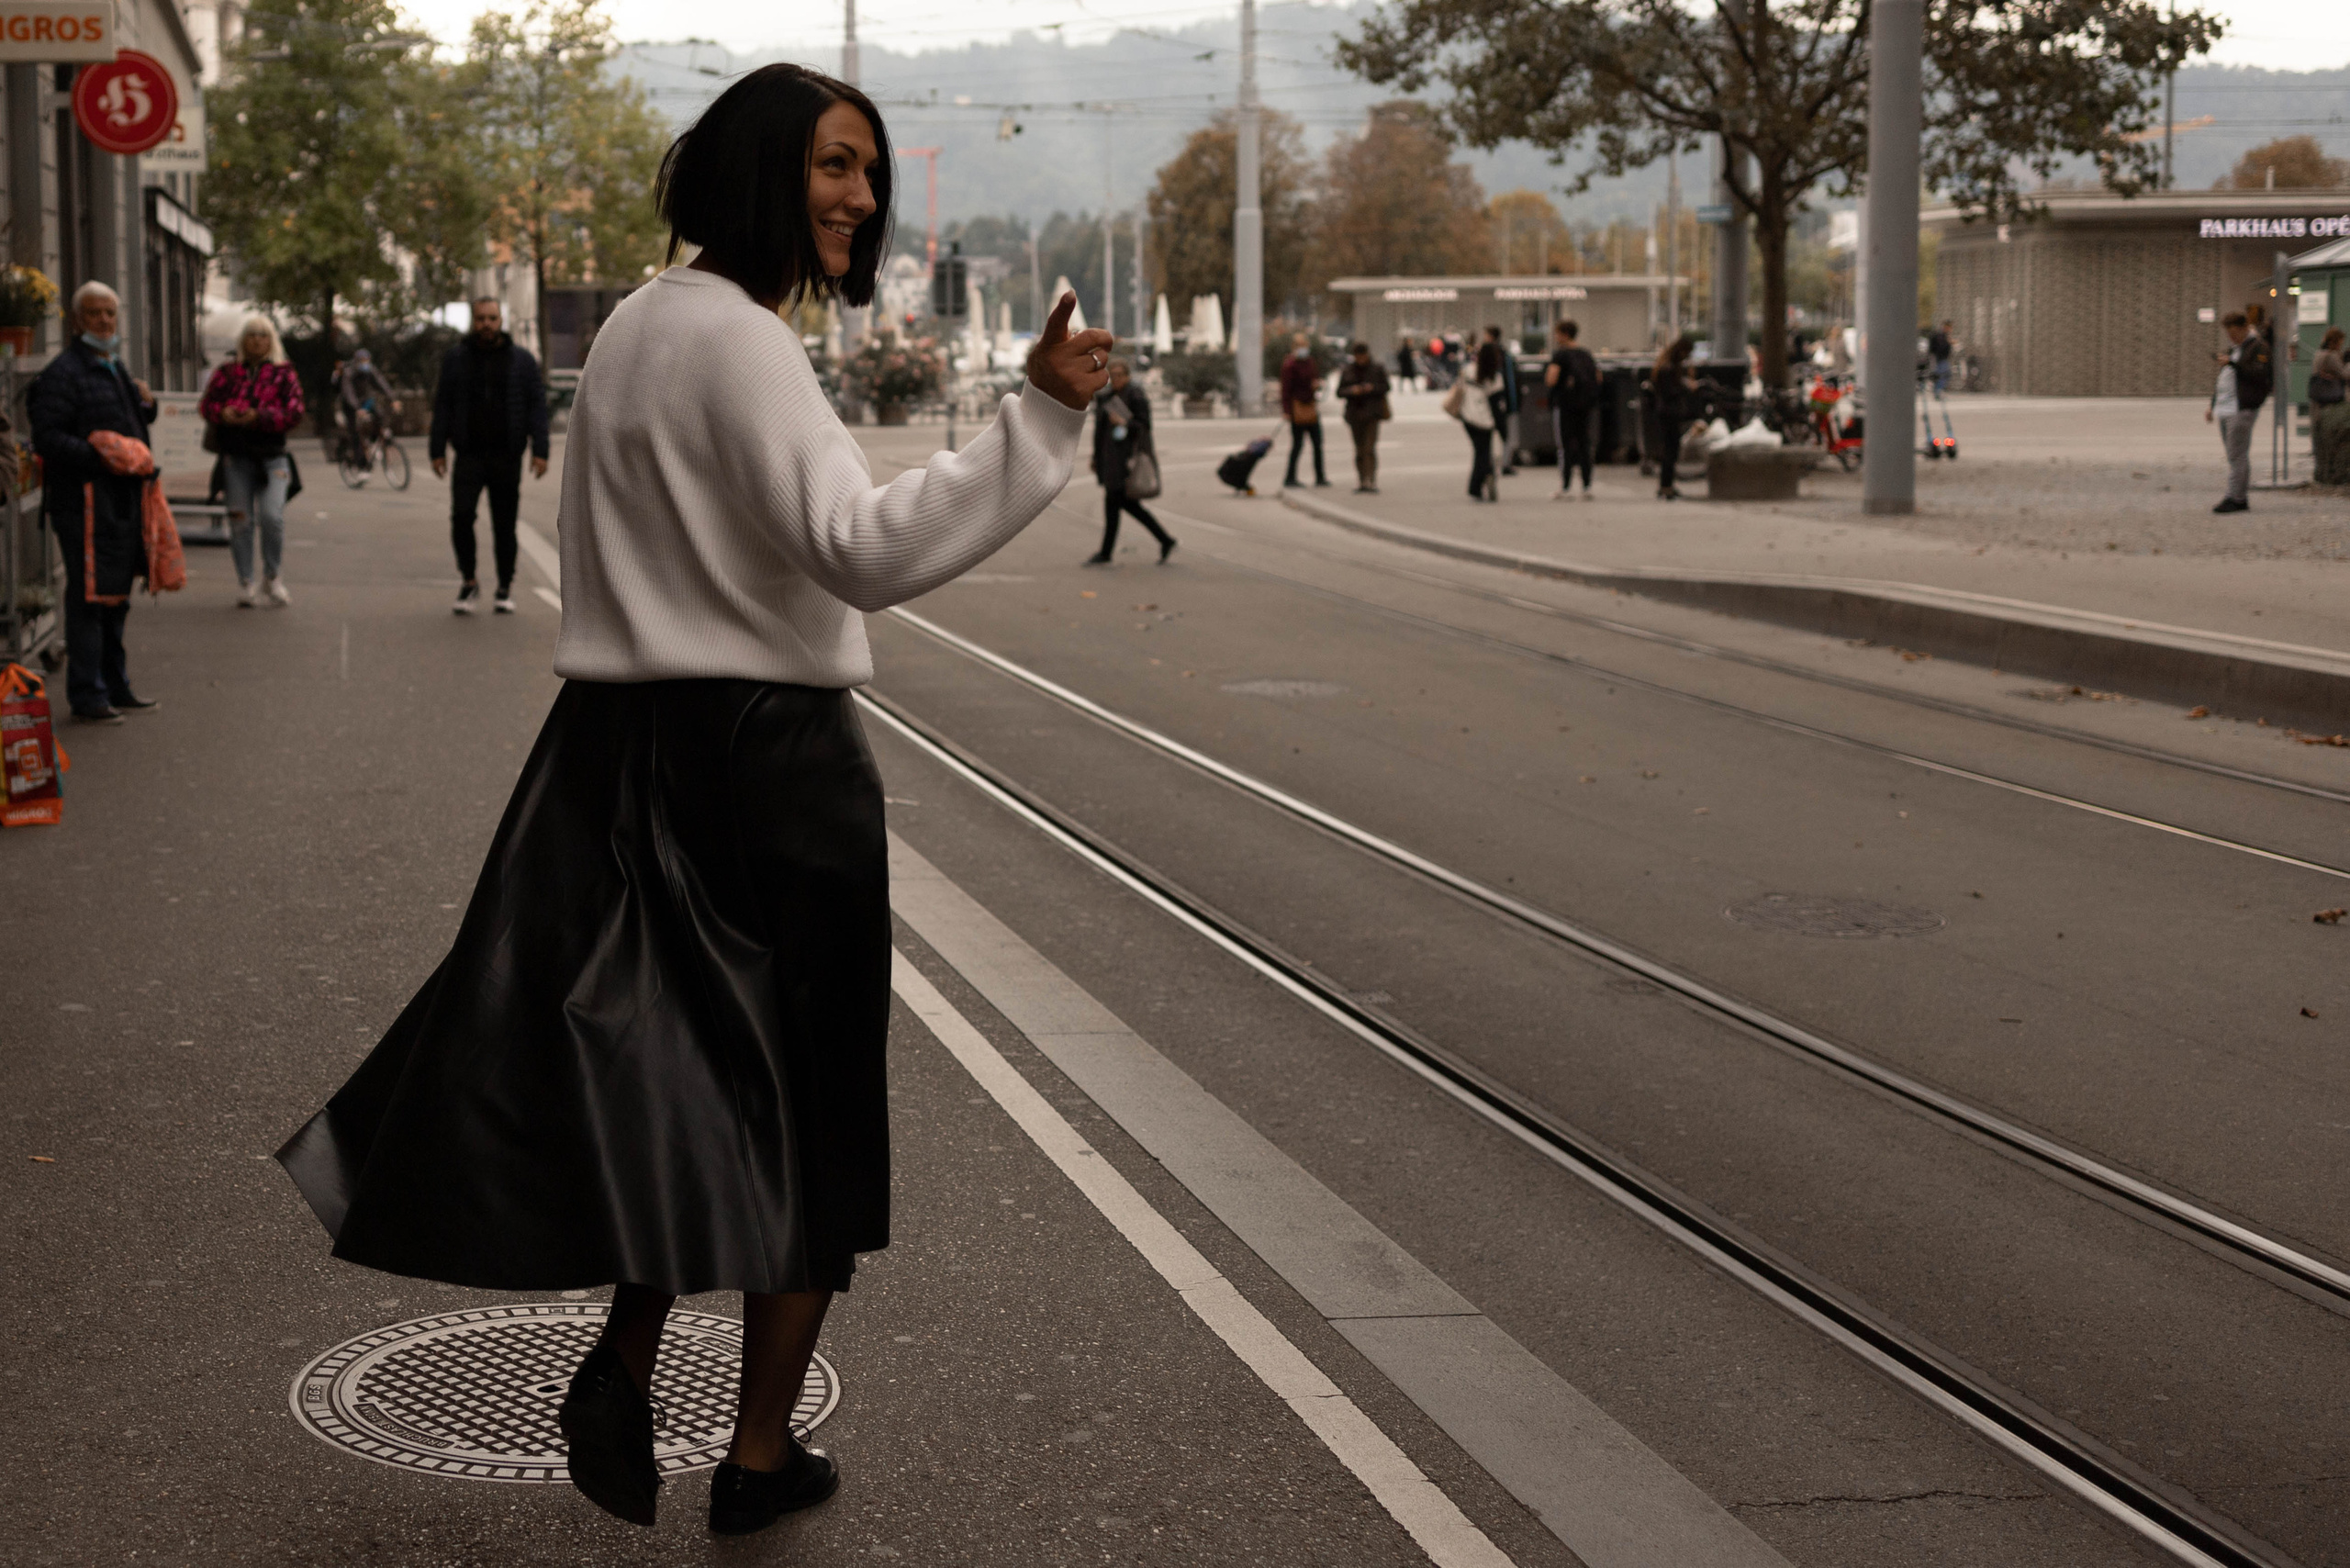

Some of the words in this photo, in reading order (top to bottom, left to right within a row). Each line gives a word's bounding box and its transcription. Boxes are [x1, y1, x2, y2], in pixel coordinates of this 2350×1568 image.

[2199, 218, 2306, 238] PARKHAUS
[308, 1384, 321, 1402] BGS
[377, 1421, 448, 1448] BRUCHLAST
